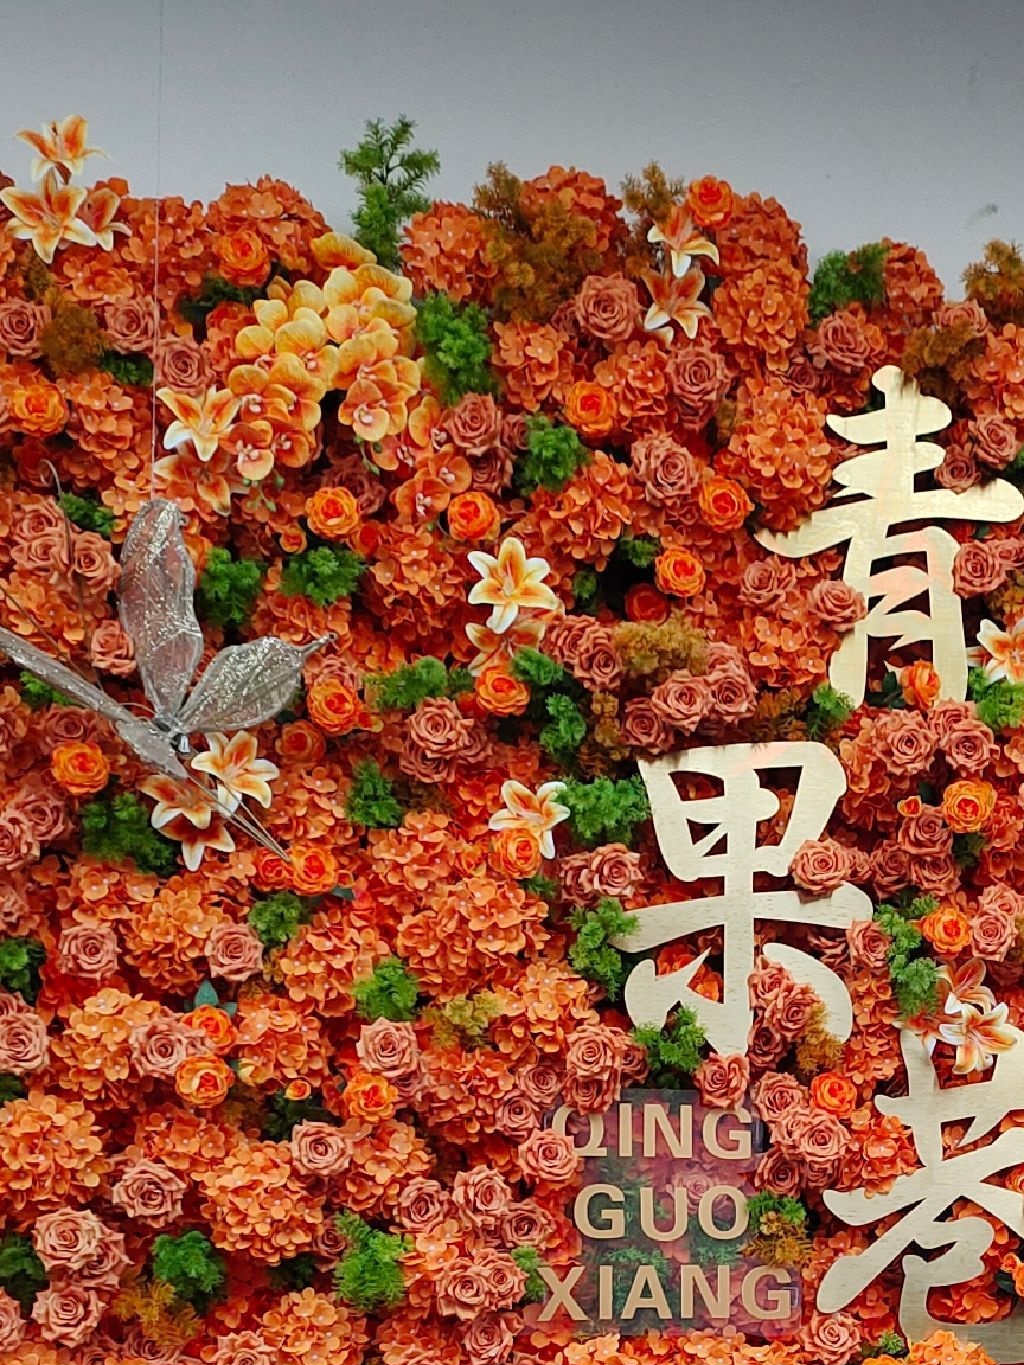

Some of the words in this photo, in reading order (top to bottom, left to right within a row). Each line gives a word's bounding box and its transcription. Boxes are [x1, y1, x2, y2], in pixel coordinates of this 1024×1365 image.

[551, 1102, 752, 1160] QING
[573, 1183, 750, 1242] GUO
[537, 1264, 793, 1321] XIANG
